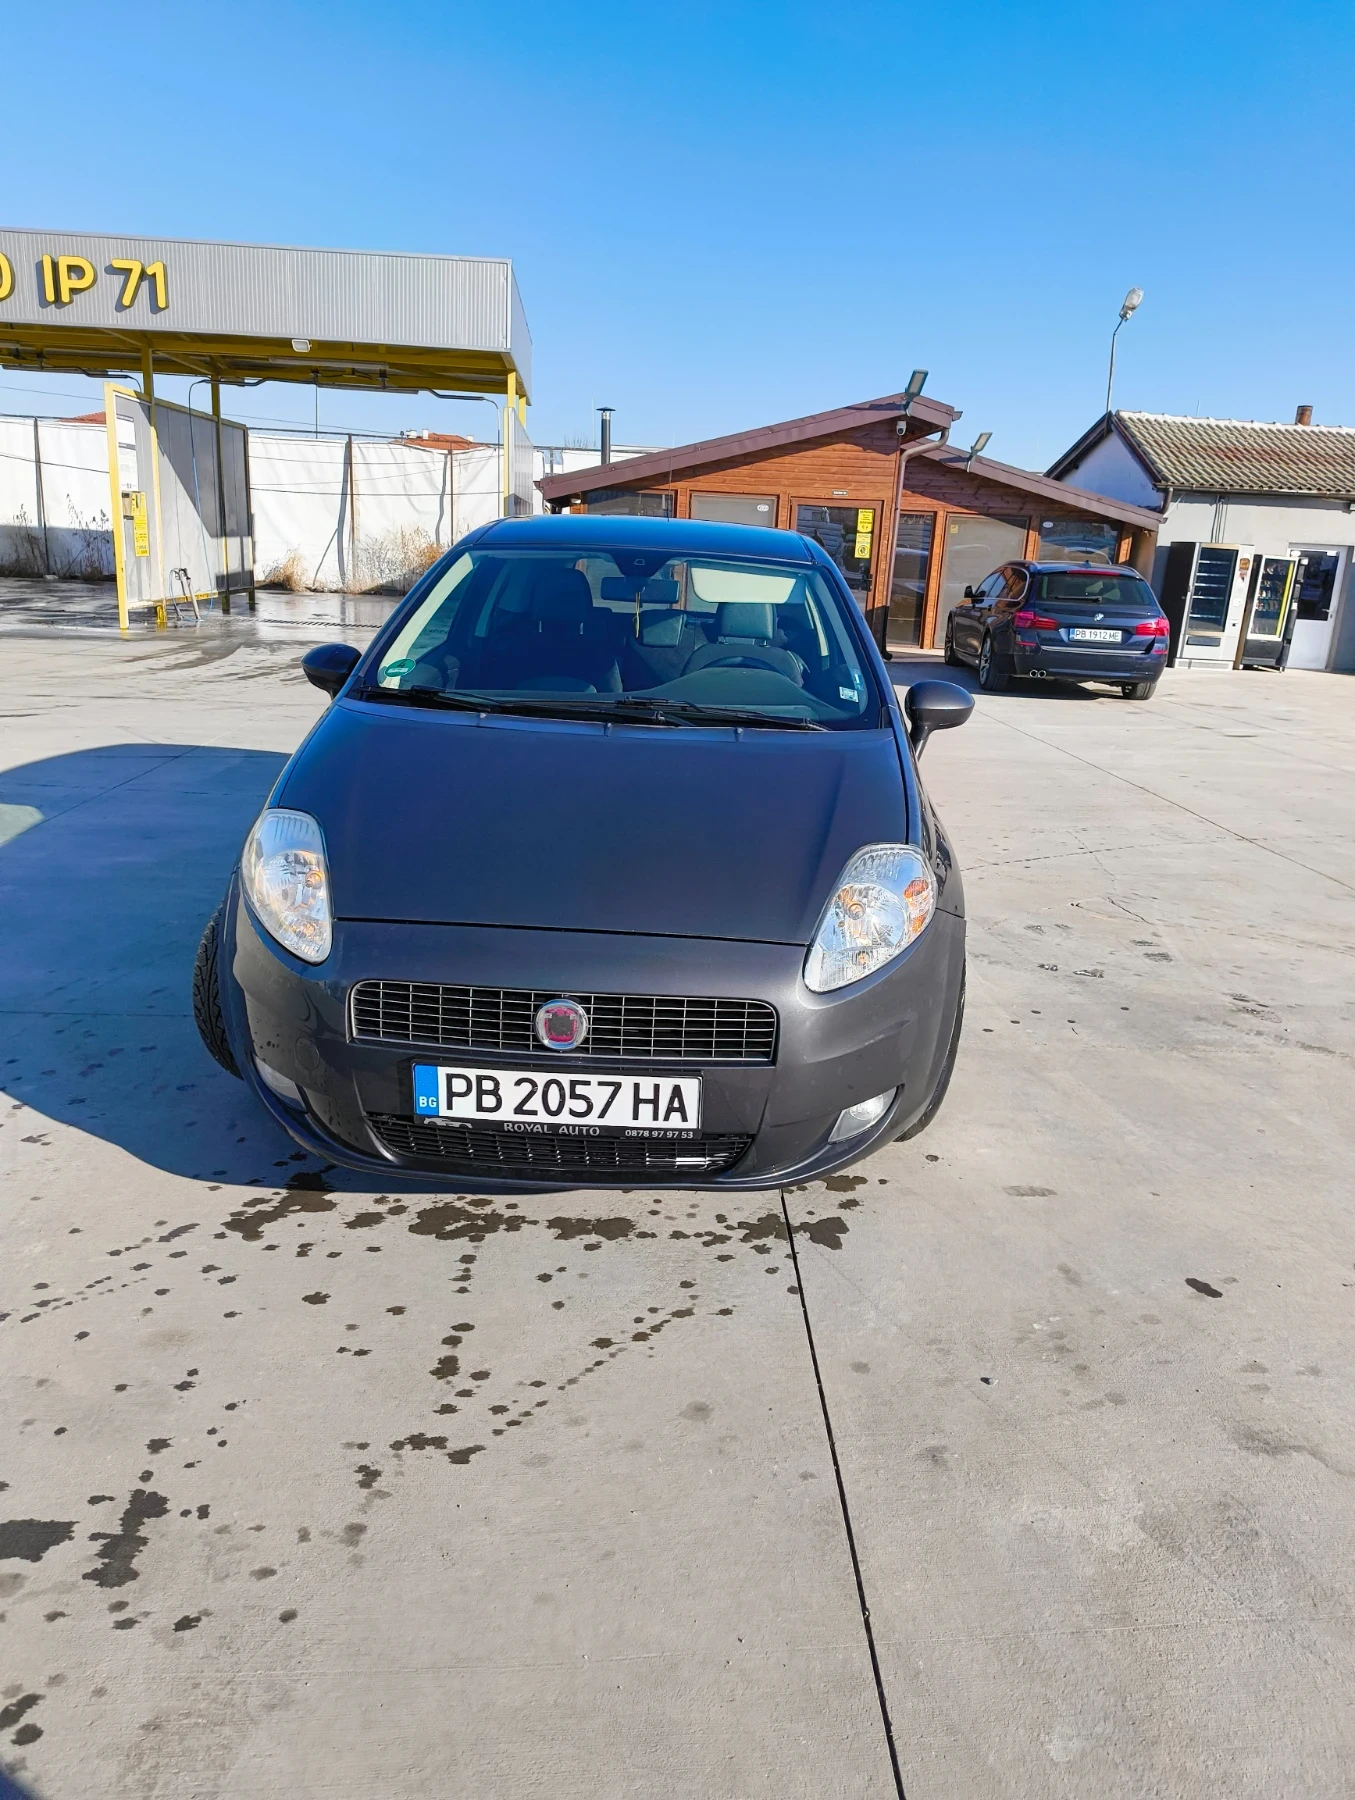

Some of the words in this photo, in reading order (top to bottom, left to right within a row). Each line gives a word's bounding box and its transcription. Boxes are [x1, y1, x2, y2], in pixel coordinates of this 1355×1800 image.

[42, 254, 96, 304] IP
[111, 257, 168, 310] 71
[1075, 630, 1087, 639] PB
[1089, 631, 1108, 640] 1912
[419, 1096, 437, 1108] BG
[445, 1073, 502, 1113] PB
[513, 1077, 623, 1119] 2057
[631, 1082, 689, 1123] HA
[503, 1122, 552, 1134] ROYAL
[559, 1125, 600, 1137] AUTO
[625, 1129, 650, 1138] 0878
[652, 1130, 664, 1138] 97
[666, 1131, 679, 1139] 97
[681, 1131, 694, 1139] 53
